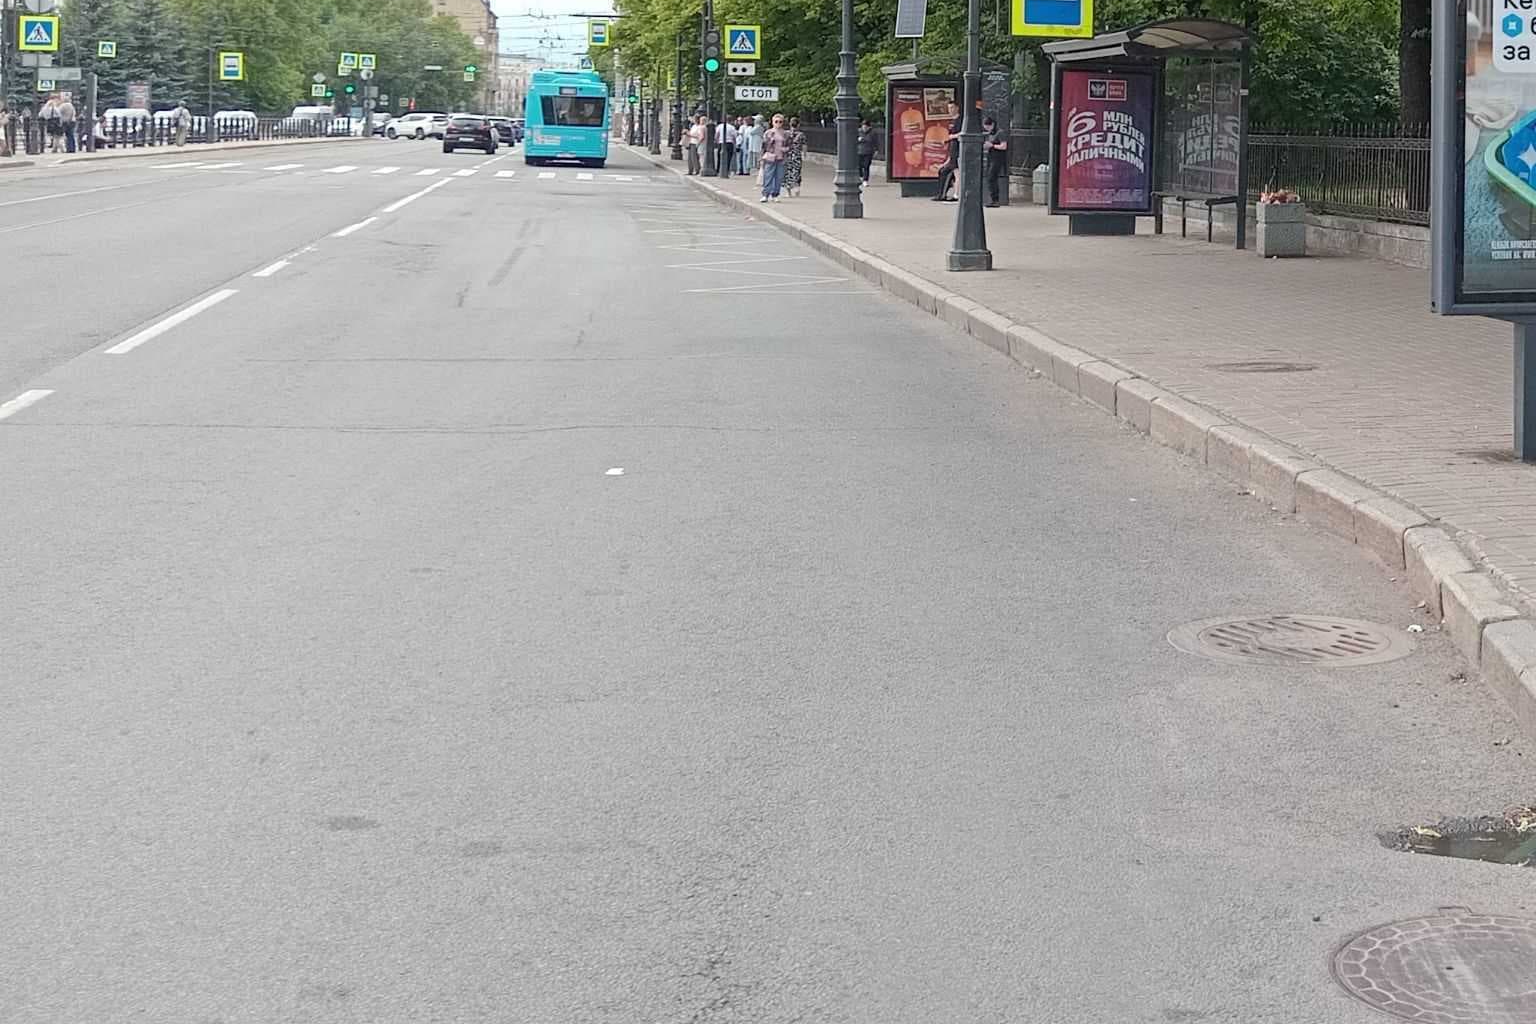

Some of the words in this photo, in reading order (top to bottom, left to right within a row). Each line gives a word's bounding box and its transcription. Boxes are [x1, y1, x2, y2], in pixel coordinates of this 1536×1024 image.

[1503, 45, 1530, 61] за
[741, 88, 772, 98] СТОП
[1067, 111, 1097, 138] 6
[1103, 110, 1133, 126] МЛН
[1103, 121, 1145, 145] РУБЛЕЙ
[1066, 132, 1145, 158] КРЕДИТ
[1066, 147, 1145, 174] НАЛИЧНЫМИ
